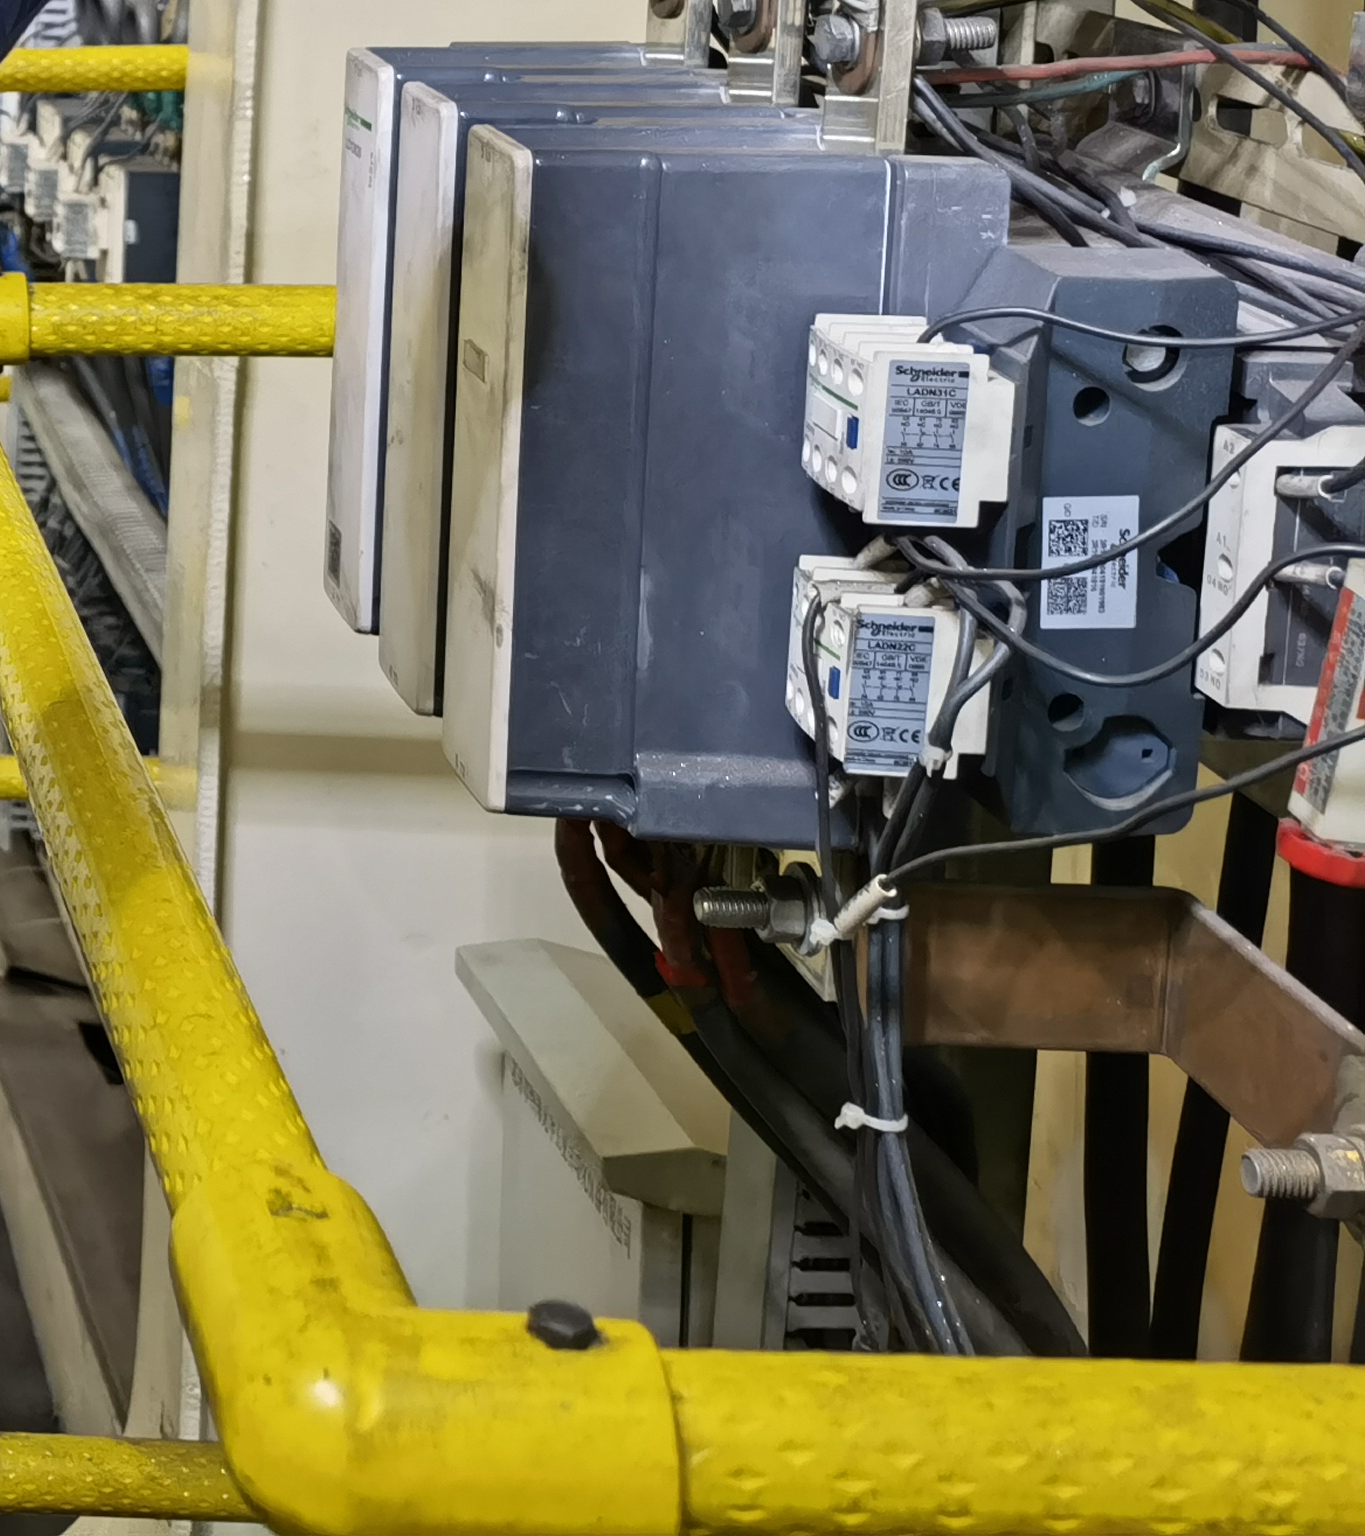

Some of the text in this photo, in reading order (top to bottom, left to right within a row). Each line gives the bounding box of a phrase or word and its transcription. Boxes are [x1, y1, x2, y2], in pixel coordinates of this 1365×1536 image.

[895, 365, 957, 381] Schneider
[907, 387, 957, 398] LADN31C
[1118, 528, 1130, 590] Sceider
[856, 619, 917, 635] Schneider
[867, 641, 916, 652] LADN22C
